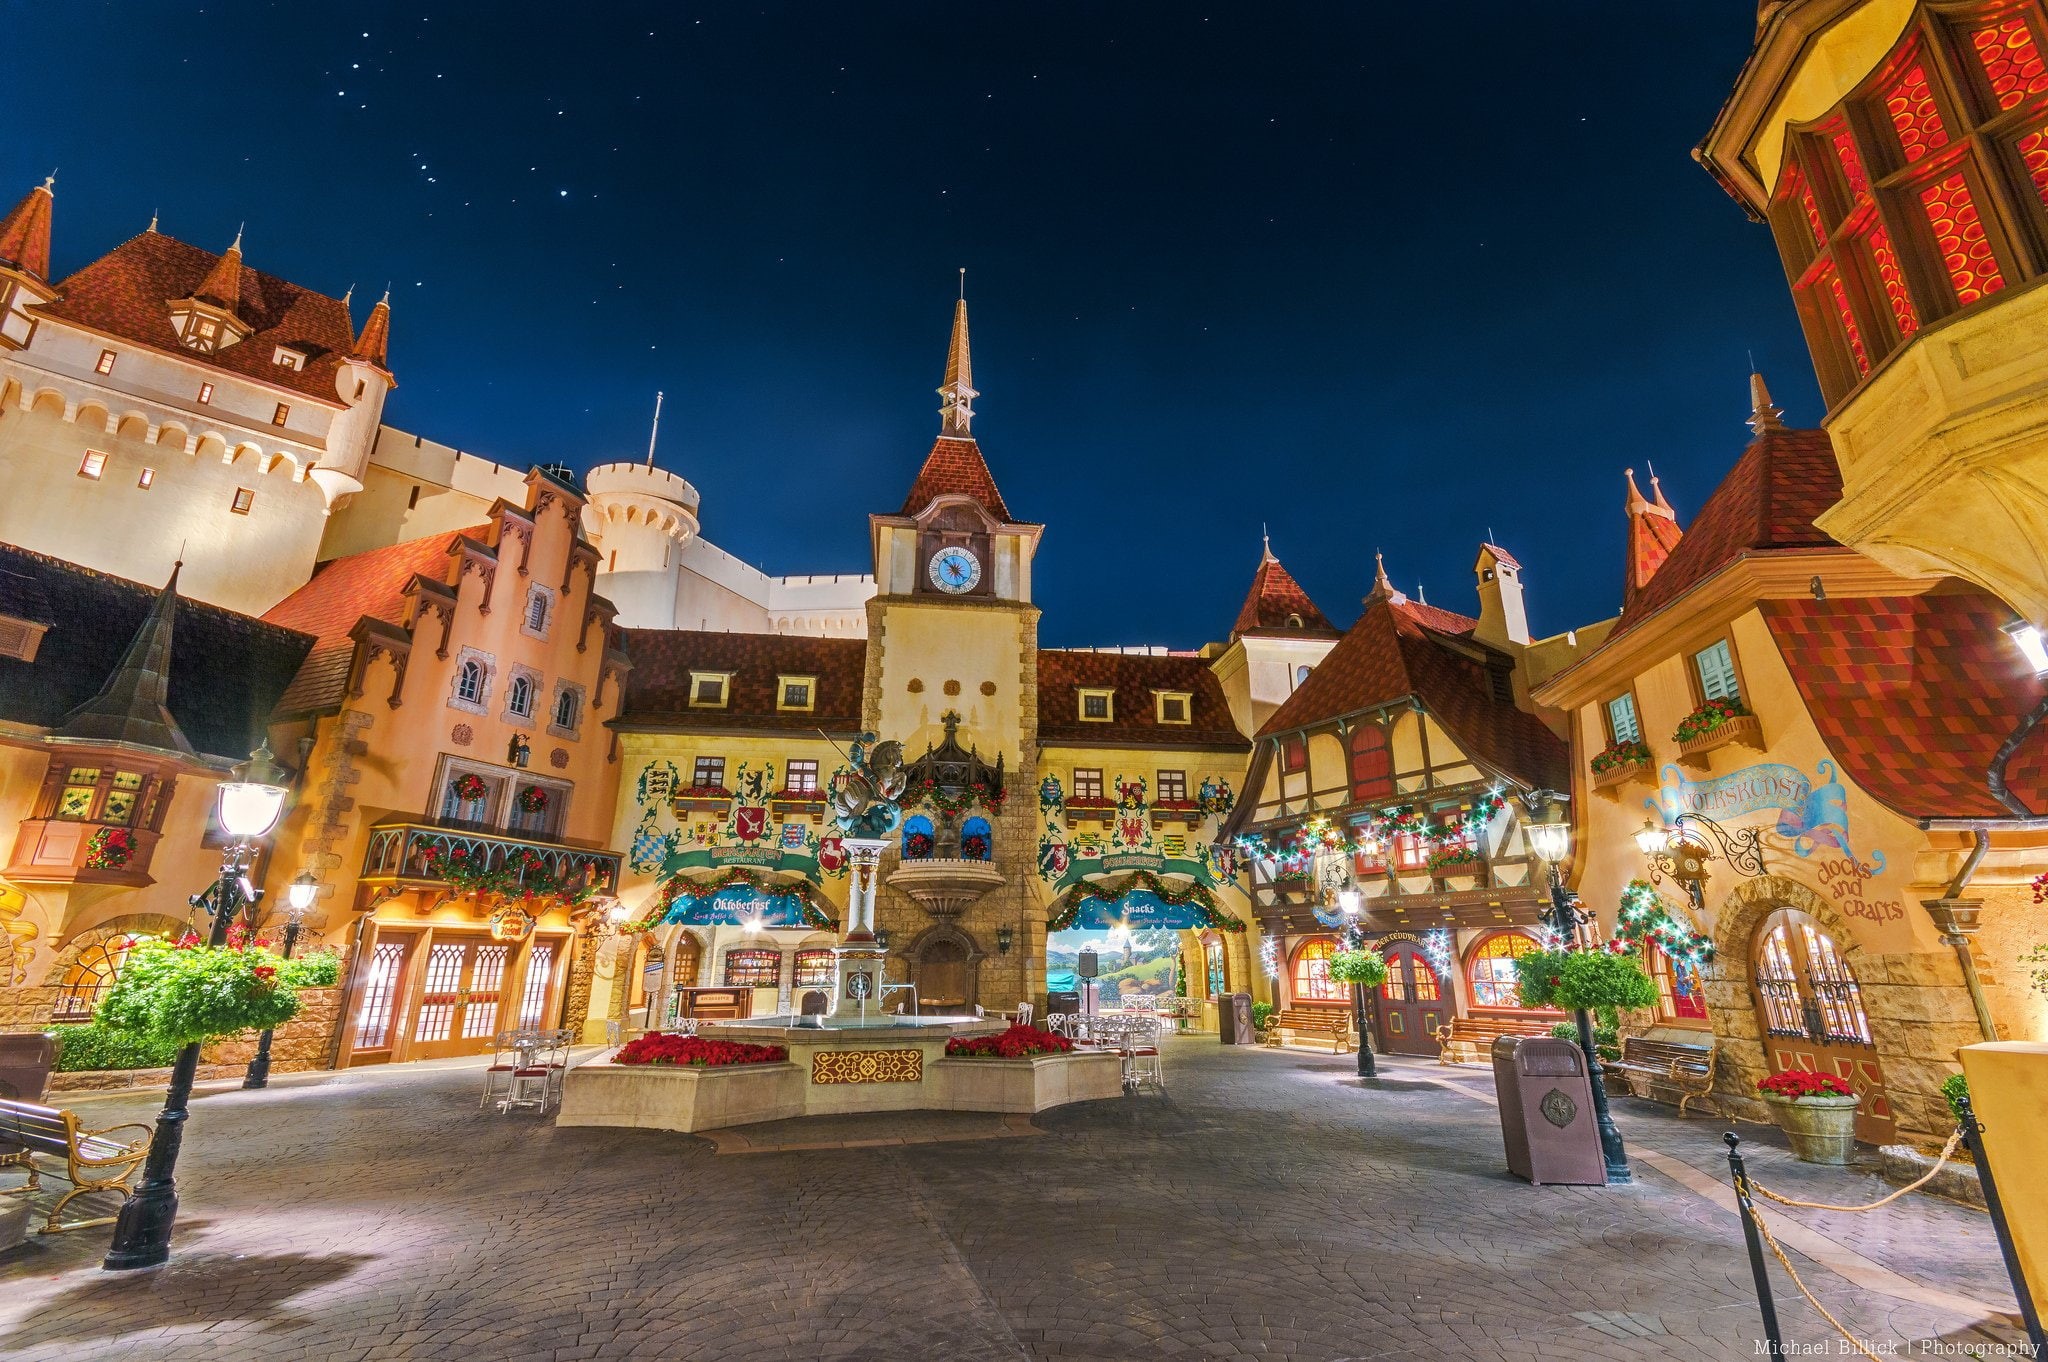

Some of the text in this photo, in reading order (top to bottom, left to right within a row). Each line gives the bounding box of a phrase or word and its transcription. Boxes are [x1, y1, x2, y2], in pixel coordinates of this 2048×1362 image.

[1831, 878, 1863, 899] and
[713, 898, 770, 915] Oktoberfest
[1121, 901, 1155, 915] Snacks
